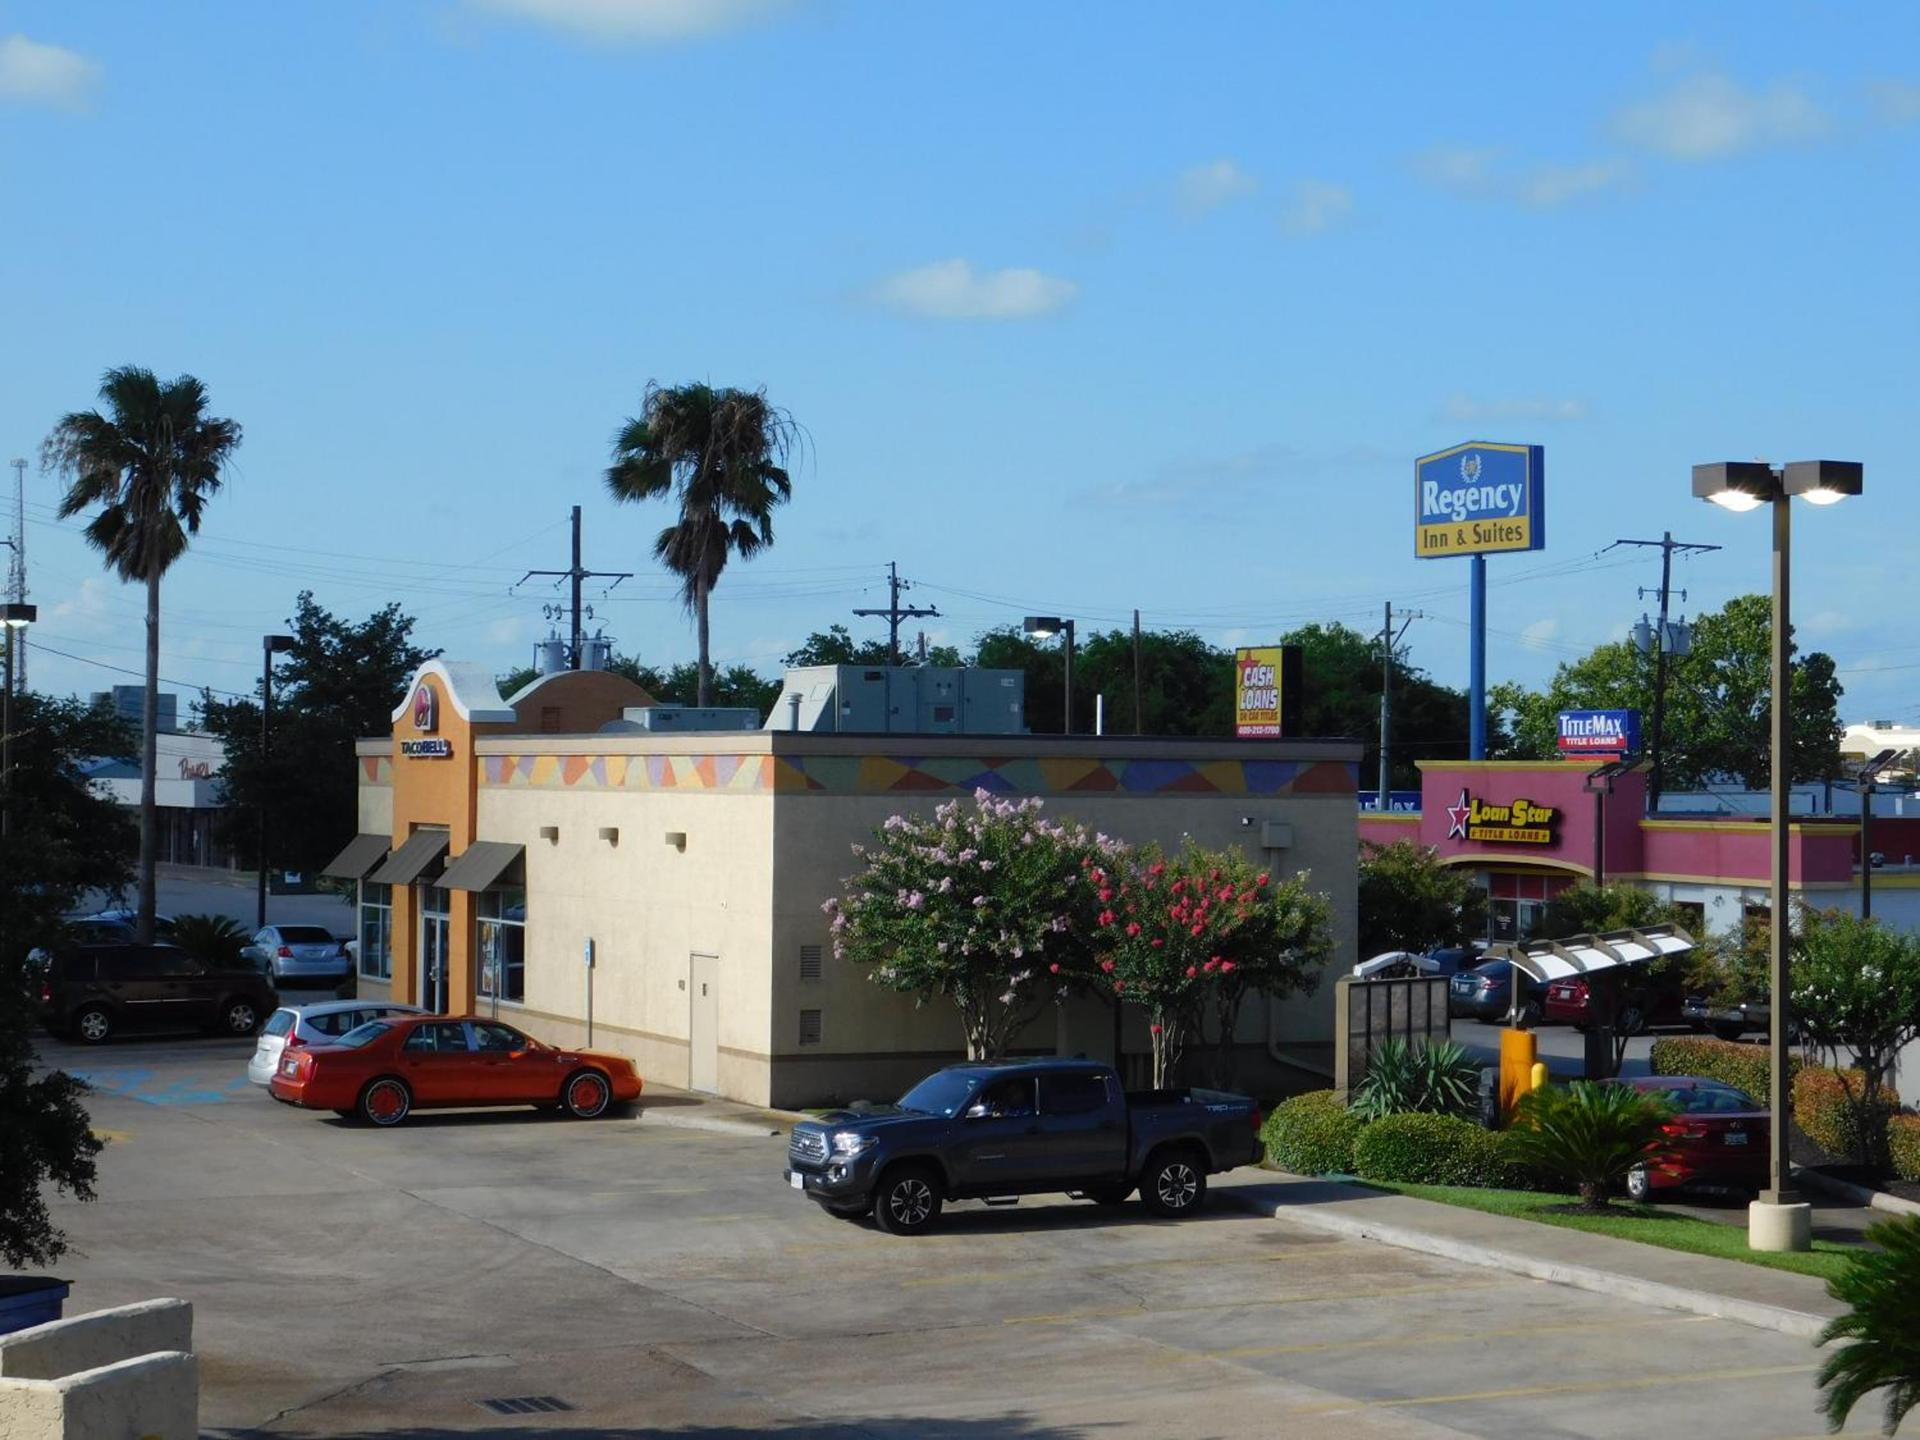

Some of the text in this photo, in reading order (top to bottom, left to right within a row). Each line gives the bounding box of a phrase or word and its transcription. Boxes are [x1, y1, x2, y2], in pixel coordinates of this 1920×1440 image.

[1423, 480, 1522, 521] Regency
[1423, 522, 1523, 548] Inn & Suites
[1243, 665, 1275, 687] CASH
[1240, 688, 1278, 710] LOANS
[1566, 737, 1617, 745] TITLE LOANS
[1469, 799, 1553, 827] Loan Star
[1479, 828, 1540, 840] TITLE LOANS
